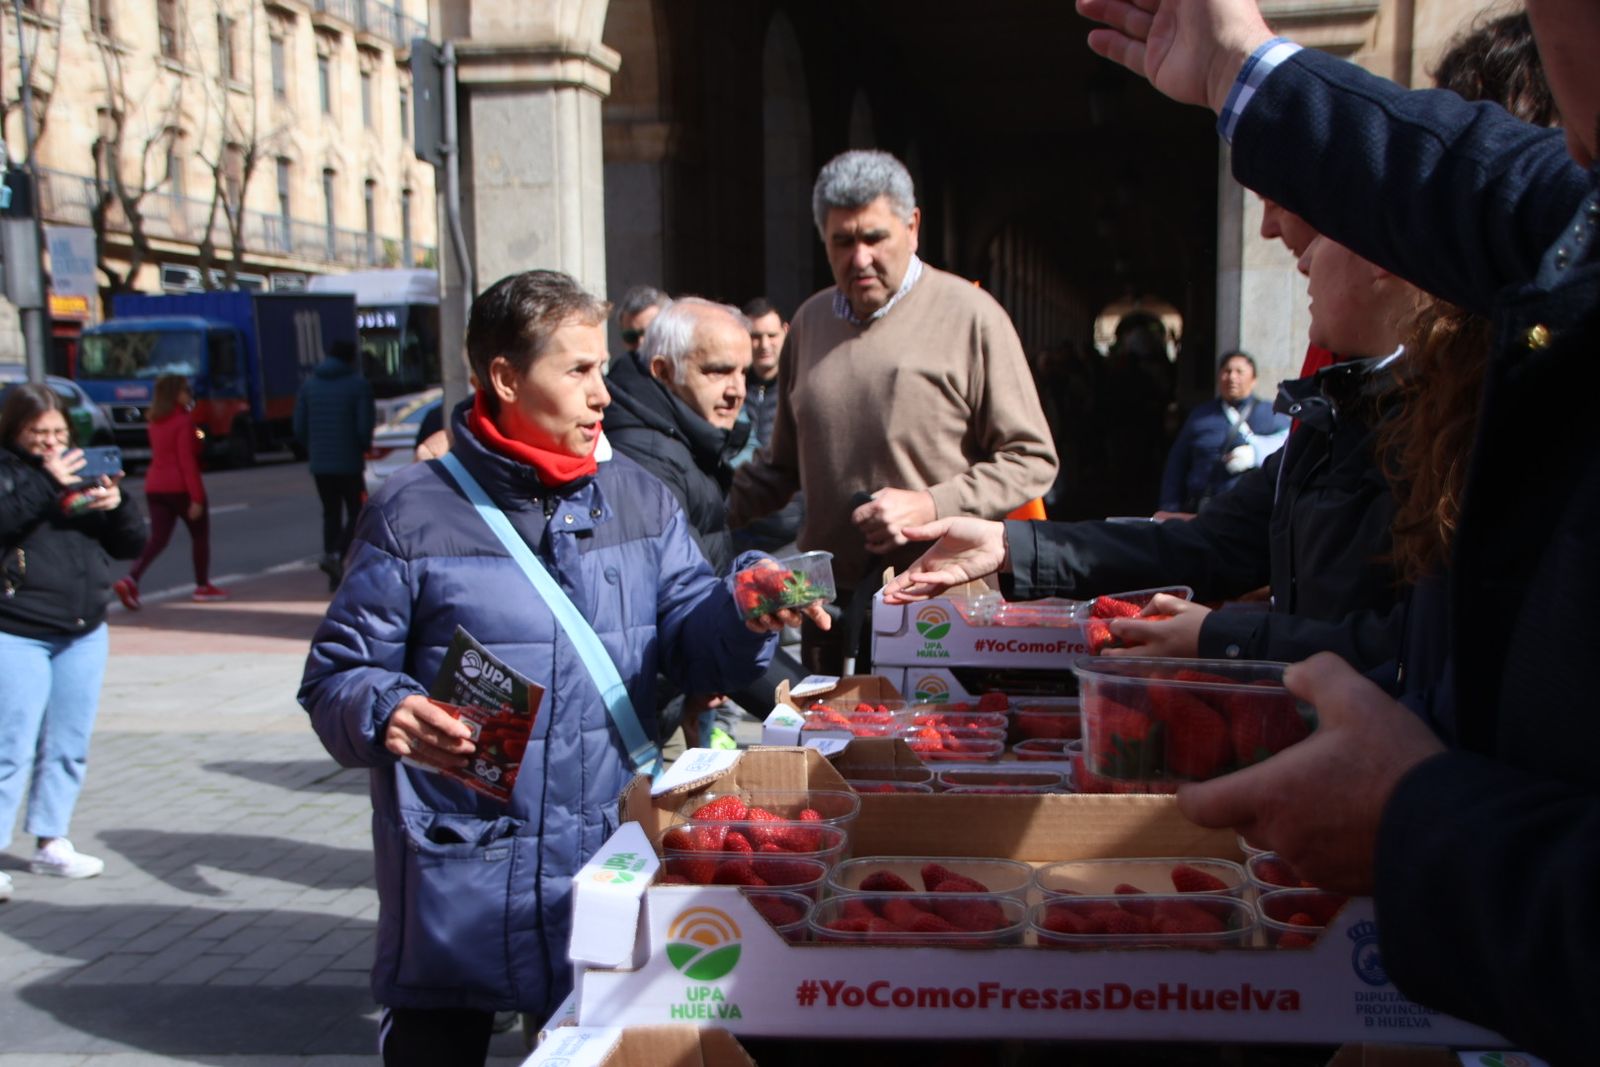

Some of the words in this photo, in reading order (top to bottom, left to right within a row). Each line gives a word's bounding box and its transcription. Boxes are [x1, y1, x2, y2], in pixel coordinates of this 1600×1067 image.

[923, 641, 943, 650] UPA
[974, 638, 1089, 654] #YoComoFre
[916, 650, 950, 659] HUELVA
[481, 661, 513, 694] UPA
[602, 852, 639, 871] UPA
[687, 986, 725, 1003] UPA
[796, 980, 1301, 1012] #YoComoFresasDeHuelva
[1354, 991, 1407, 1002] DIPUTA
[670, 1002, 742, 1021] HUELVA
[1377, 1016, 1433, 1028] HUELVA
